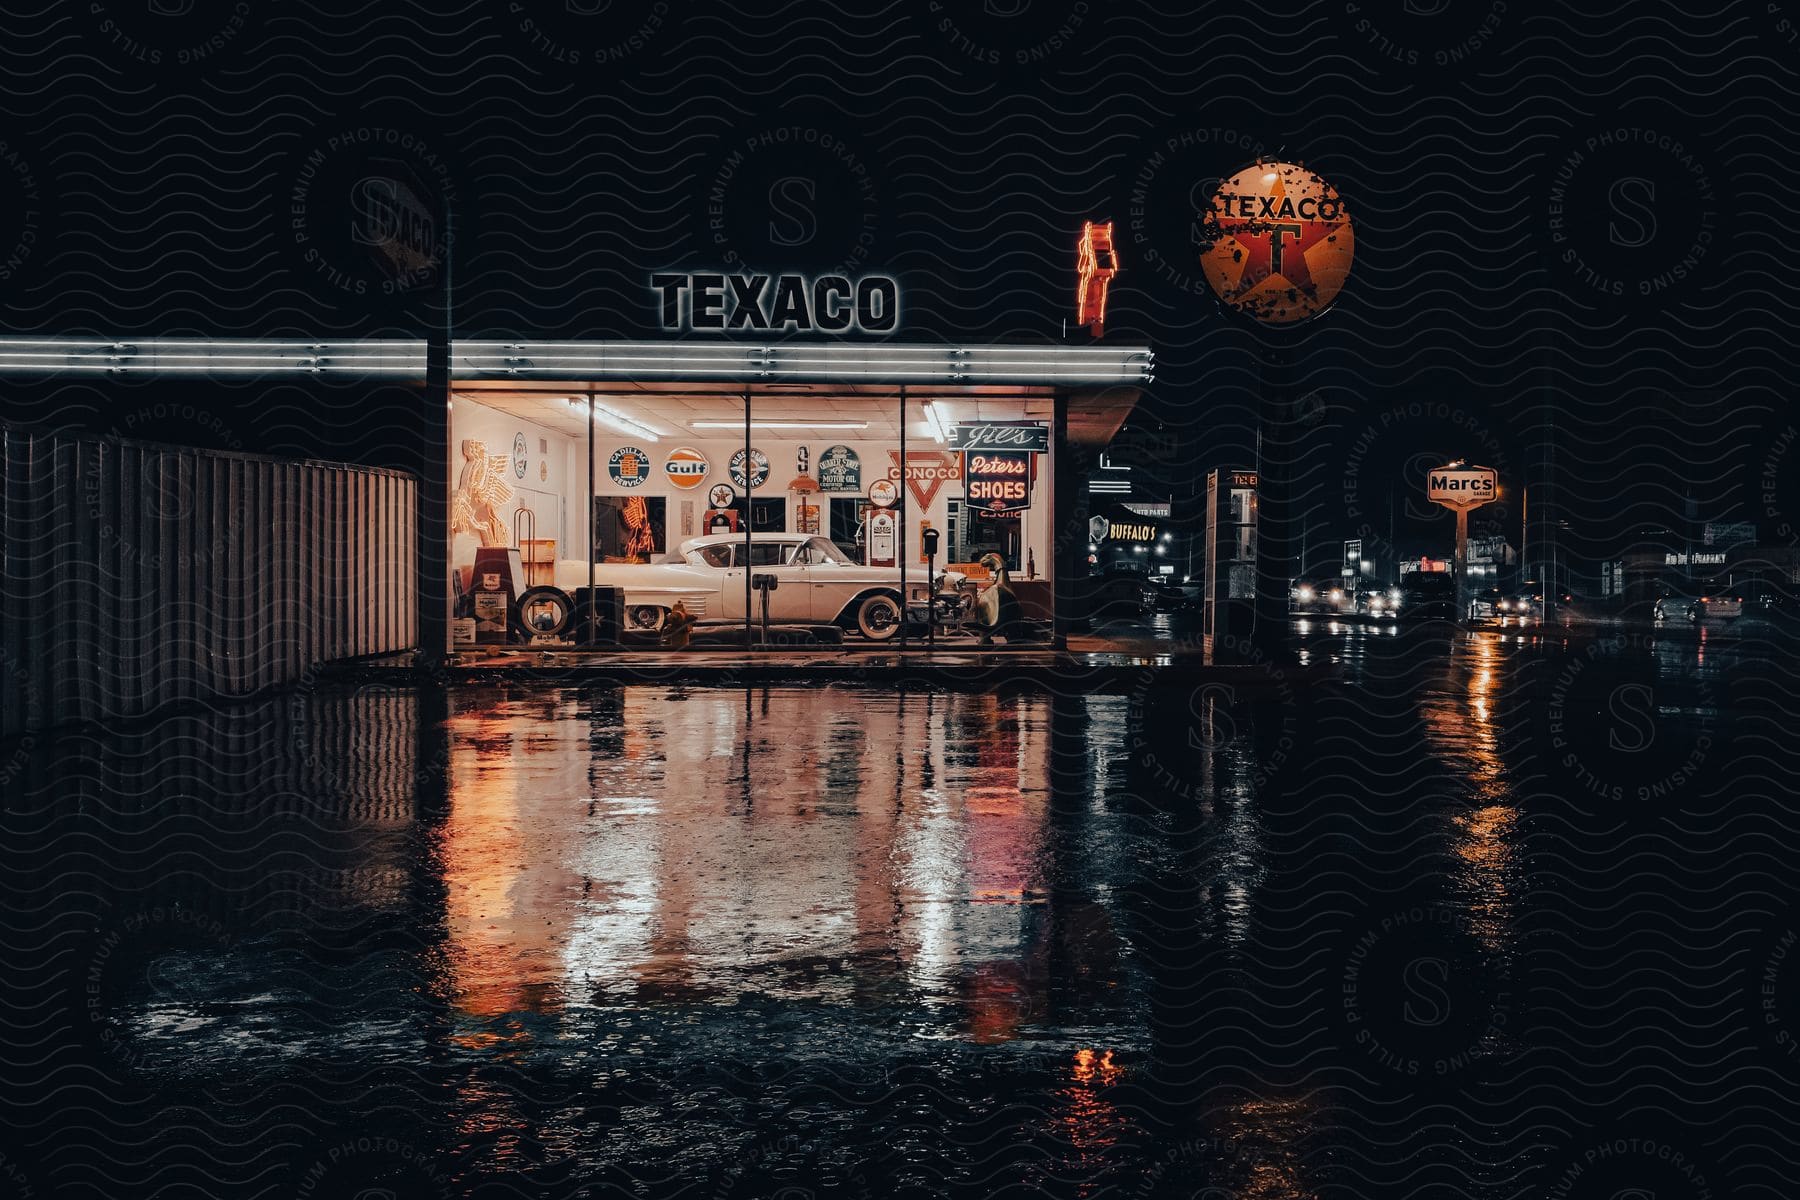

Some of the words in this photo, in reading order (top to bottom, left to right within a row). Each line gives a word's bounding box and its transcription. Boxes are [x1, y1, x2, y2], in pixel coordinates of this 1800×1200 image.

[1219, 194, 1338, 221] TEXACO
[651, 274, 897, 333] TEXACO
[611, 447, 648, 463] CADILLAC
[665, 462, 706, 474] Gulf
[969, 455, 1026, 474] Peters
[613, 475, 645, 487] SERVICE
[734, 474, 763, 486] SERICE
[889, 468, 959, 479] CONOCO
[969, 481, 1026, 499] SHOES
[1431, 474, 1493, 491] Marc's
[1110, 524, 1156, 541] BUFFALO'S
